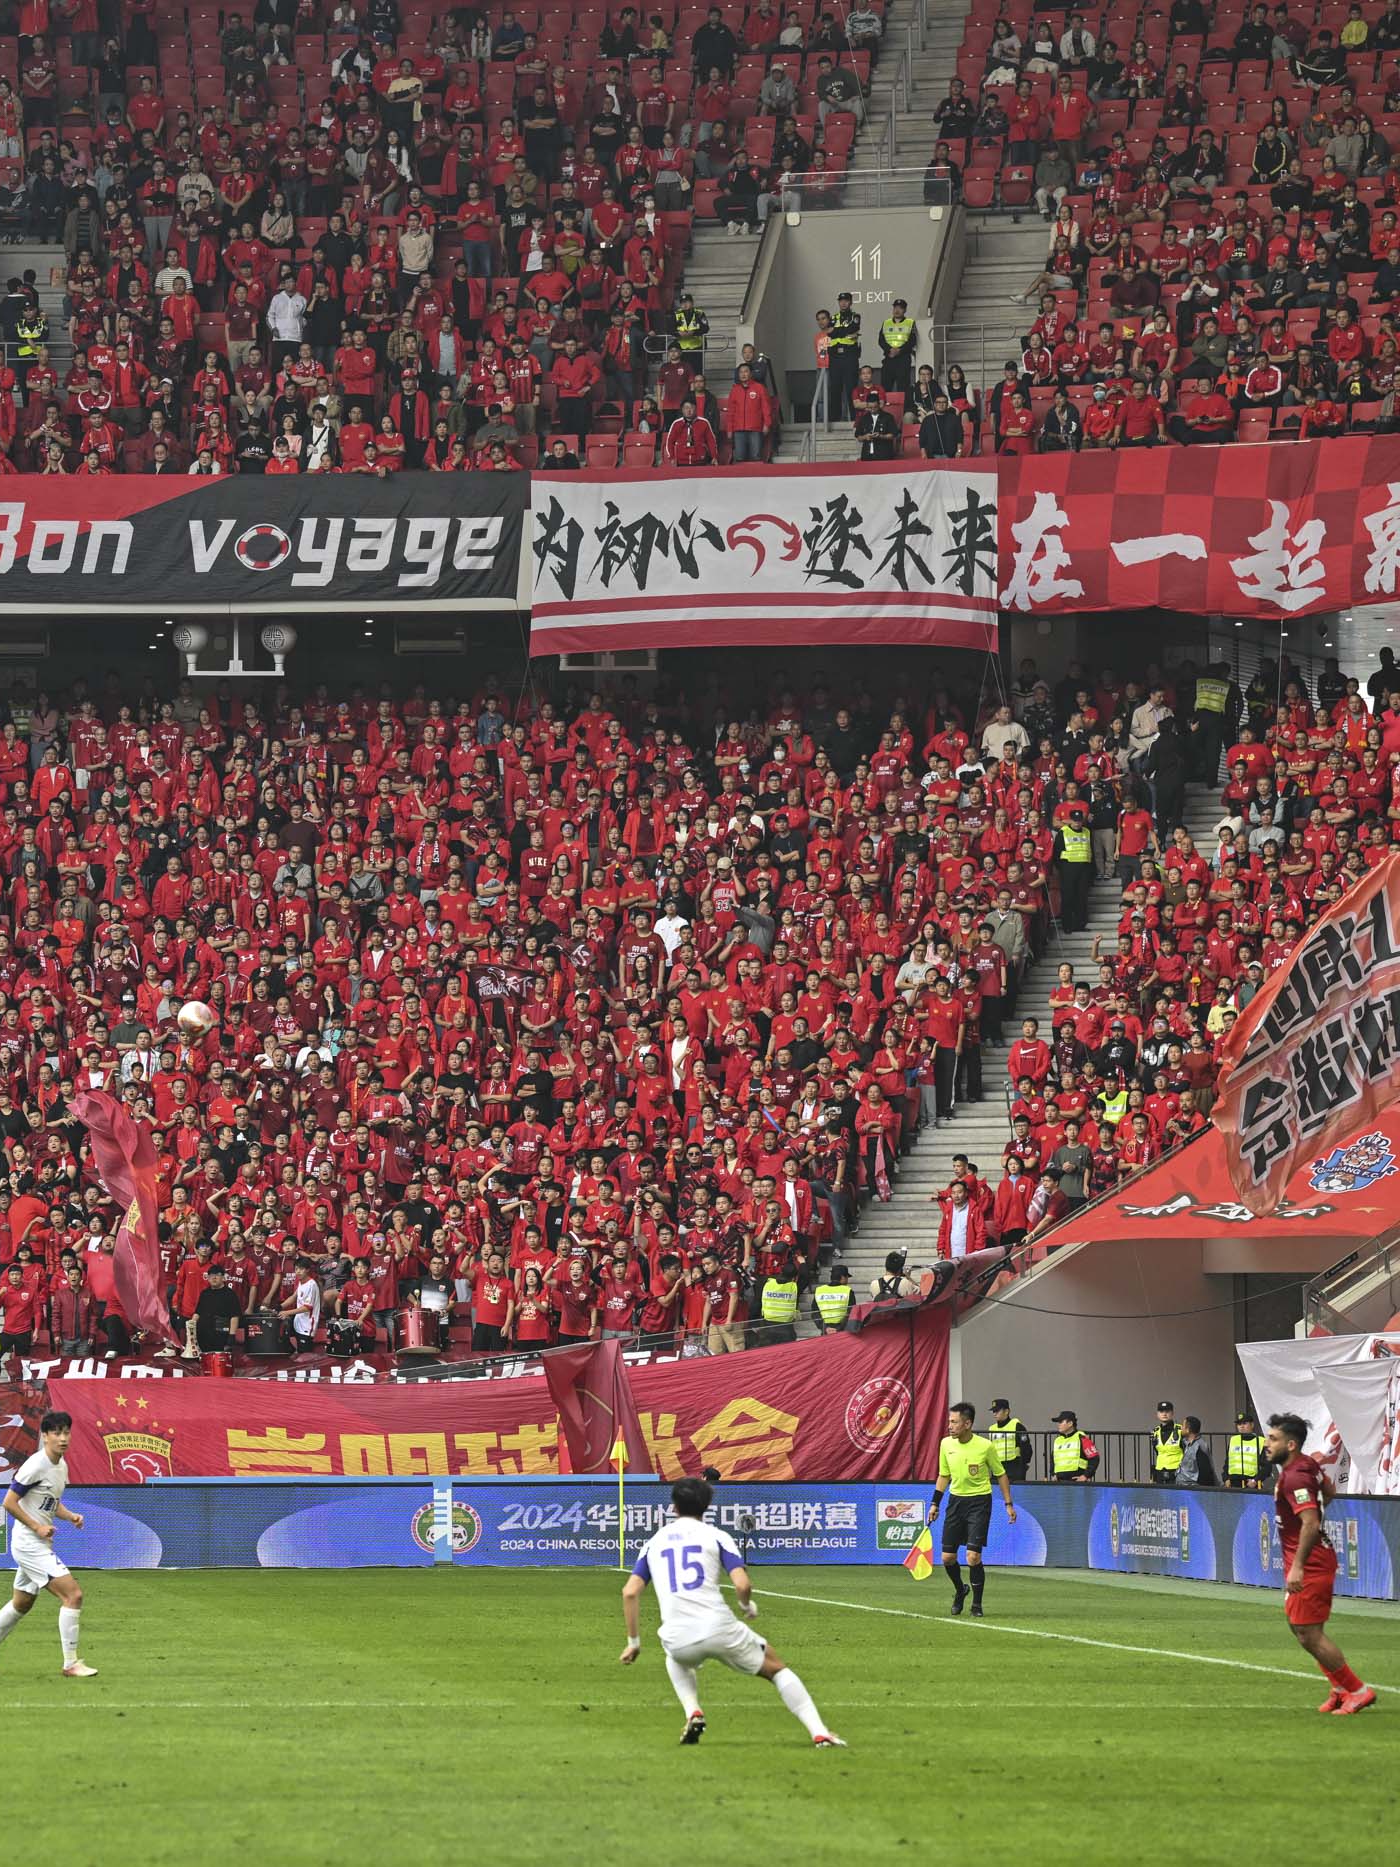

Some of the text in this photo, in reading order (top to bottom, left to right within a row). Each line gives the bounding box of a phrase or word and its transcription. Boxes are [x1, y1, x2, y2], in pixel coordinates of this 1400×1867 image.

[849, 242, 882, 281] 11
[866, 291, 894, 304] EXIT
[766, 1292, 793, 1301] SECURITY
[498, 1500, 586, 1533] 2024
[500, 1539, 534, 1551] 2024
[536, 1538, 578, 1550] CHINA
[758, 1538, 802, 1549] SUPER
[804, 1537, 857, 1549] LEAGUE
[661, 1544, 706, 1593] 15
